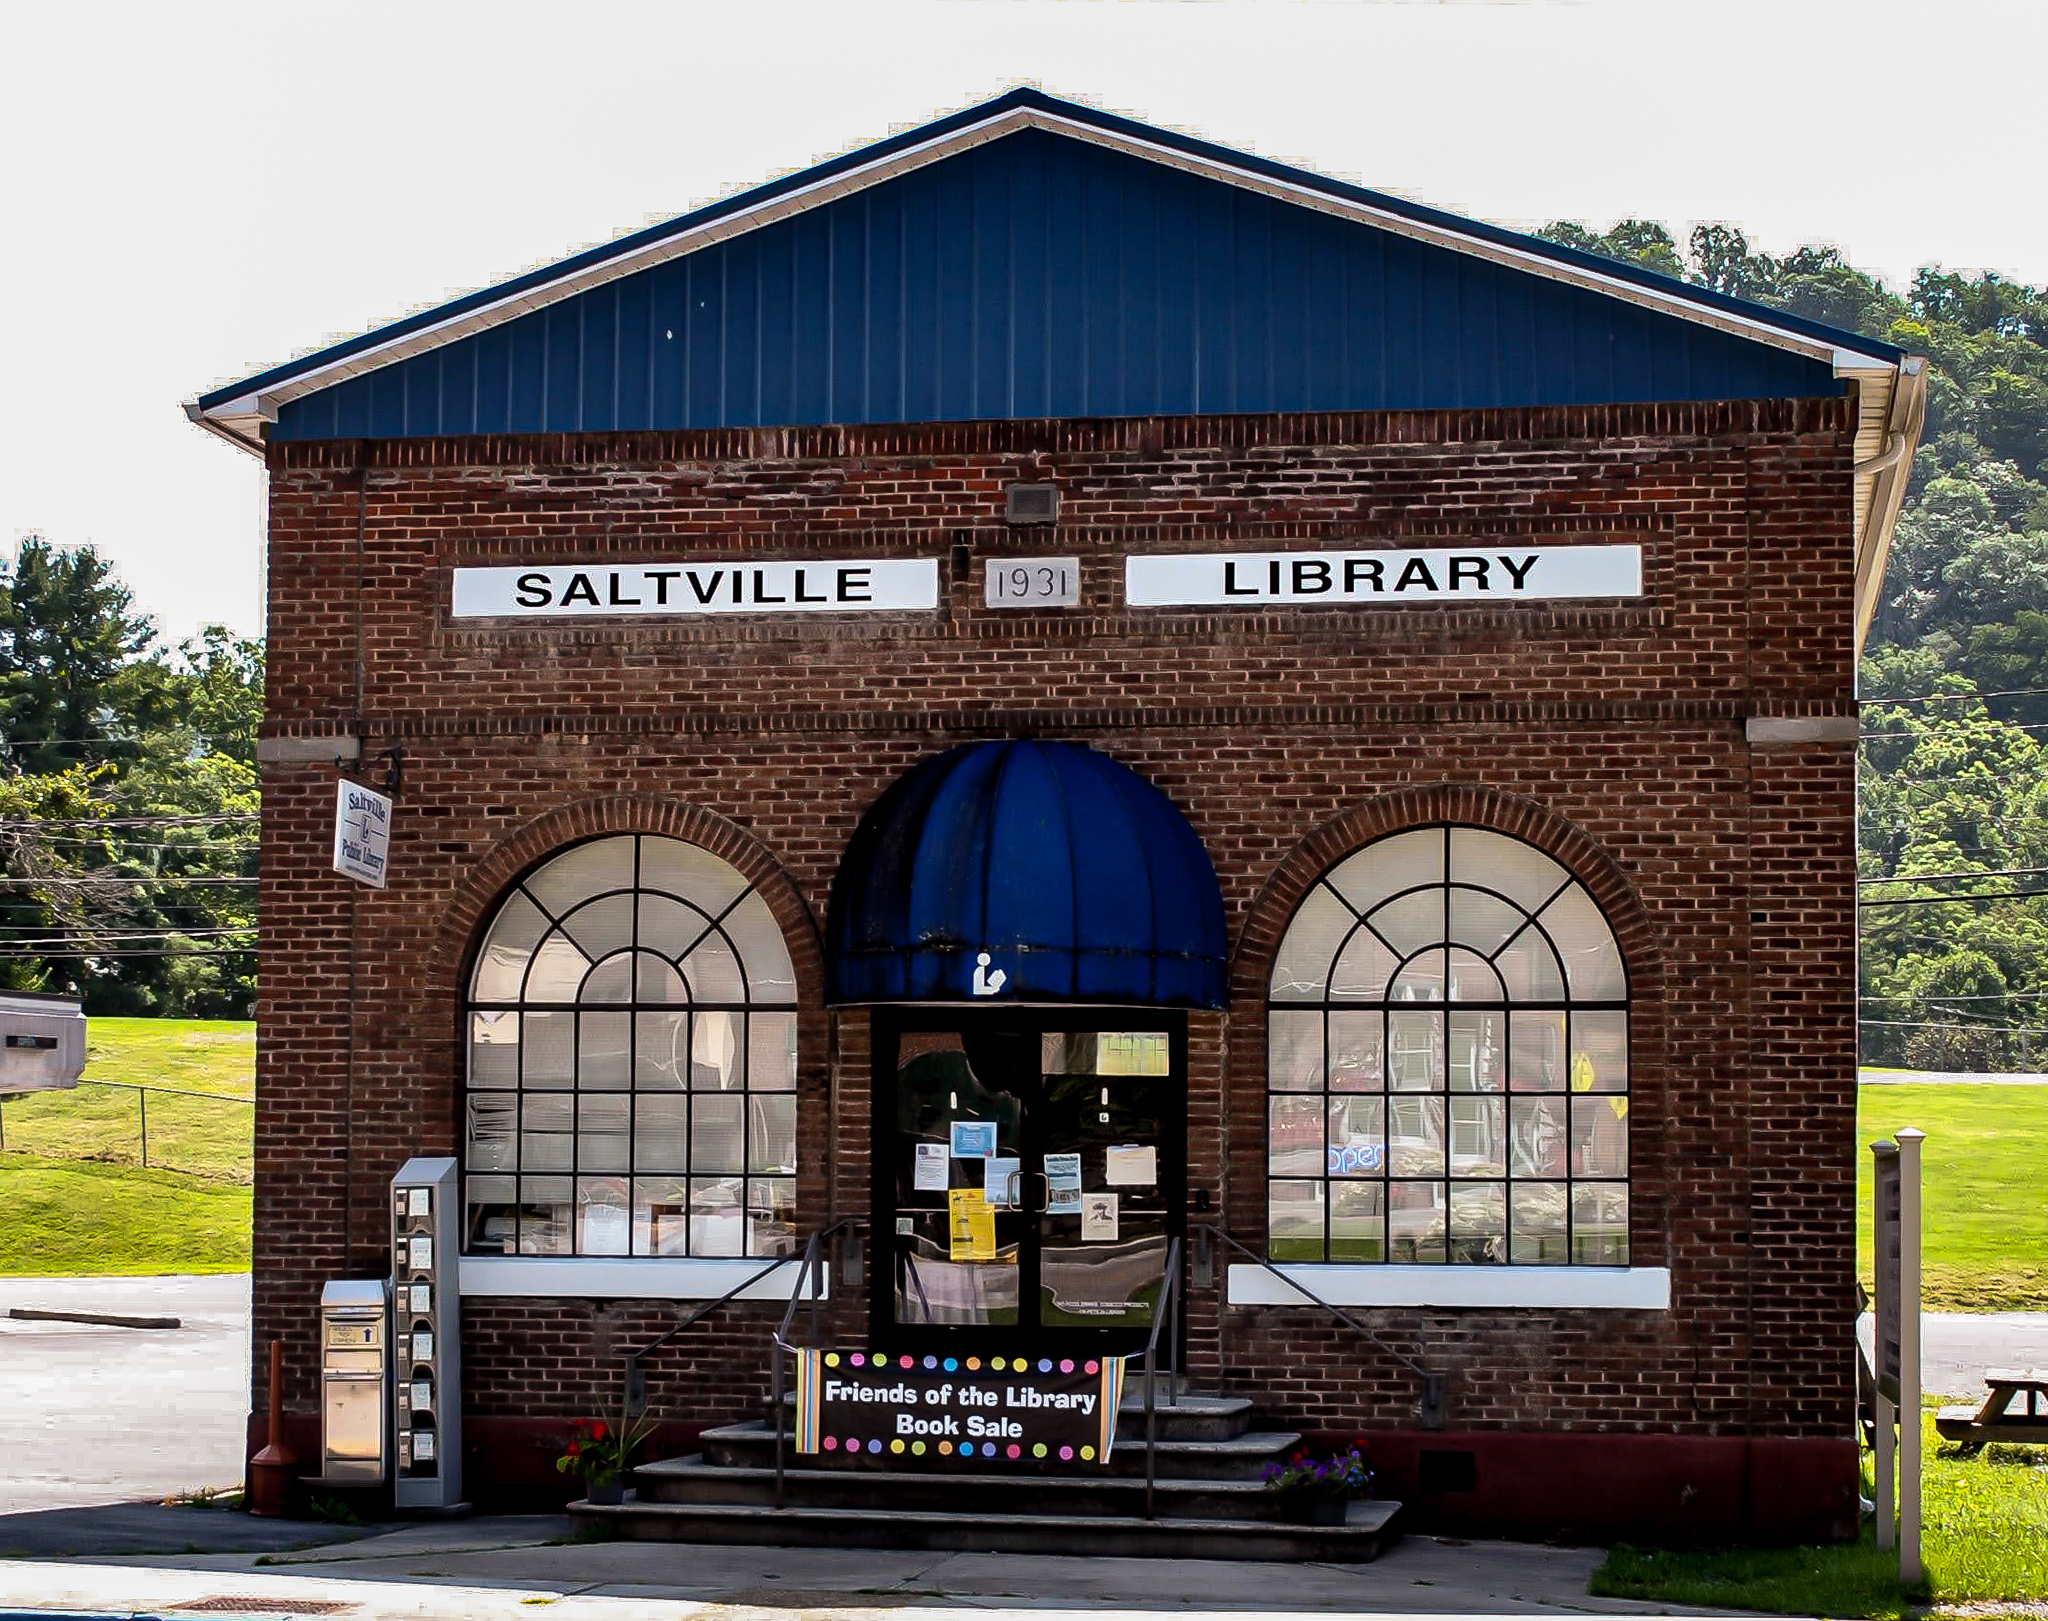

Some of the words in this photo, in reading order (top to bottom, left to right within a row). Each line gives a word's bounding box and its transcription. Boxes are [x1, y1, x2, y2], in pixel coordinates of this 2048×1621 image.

[516, 568, 872, 608] SALTVILLE
[999, 567, 1066, 598] 1931
[1223, 554, 1541, 596] LIBRARY
[348, 791, 386, 823] Saltville
[825, 1380, 918, 1405] Friends
[925, 1383, 953, 1406] of
[957, 1385, 999, 1407] the
[1006, 1386, 1097, 1415] Library
[896, 1413, 960, 1436] Book
[966, 1415, 1023, 1439] Sale
